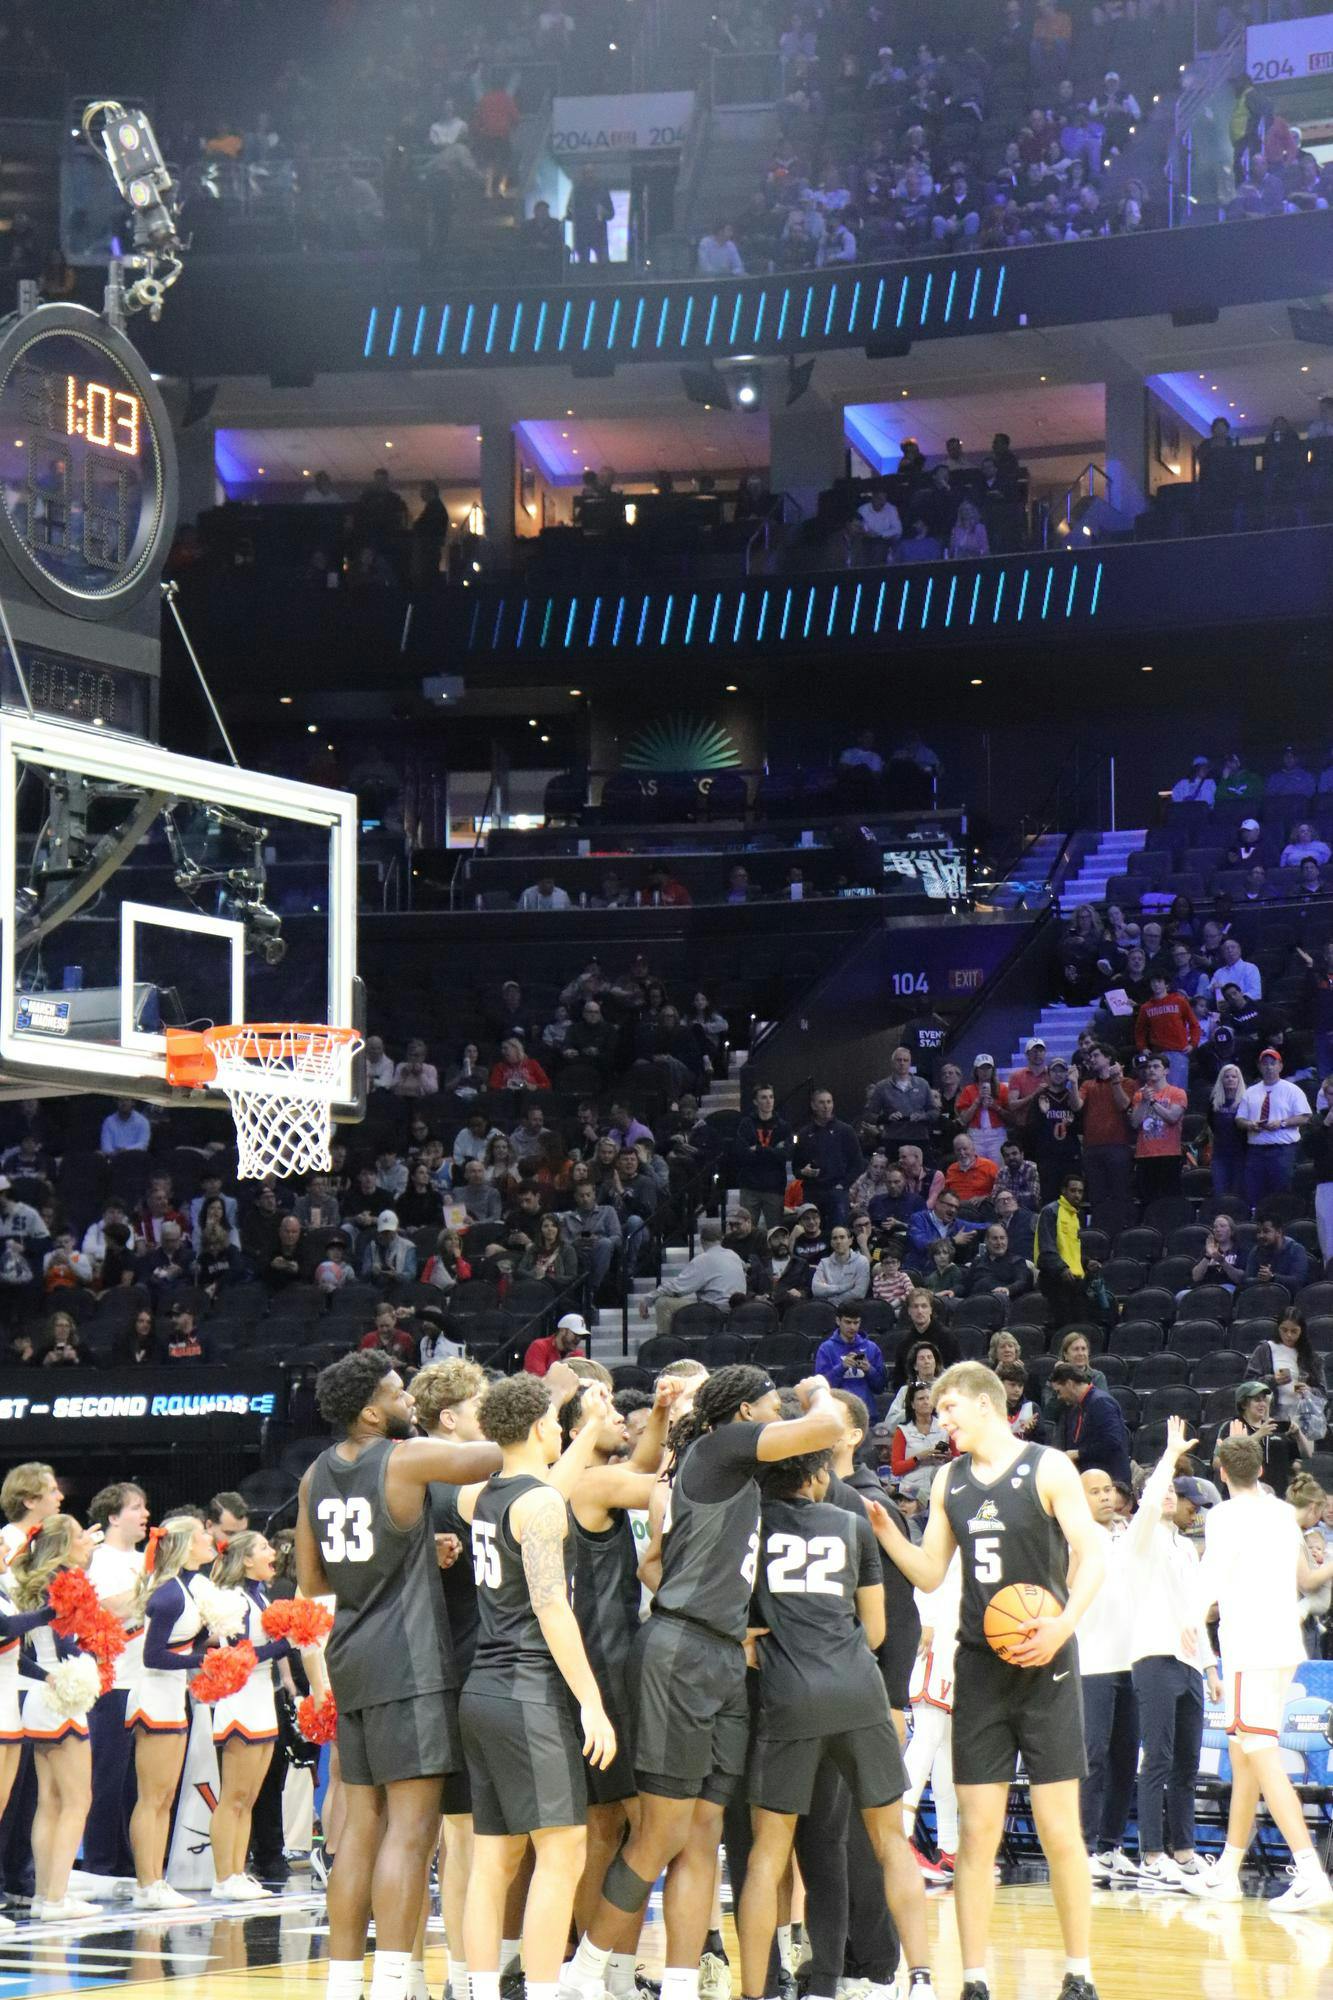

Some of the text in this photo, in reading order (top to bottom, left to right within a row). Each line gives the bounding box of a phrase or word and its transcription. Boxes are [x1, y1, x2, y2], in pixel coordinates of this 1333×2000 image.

[1252, 58, 1294, 81] 204
[555, 130, 609, 149] 204A
[649, 127, 687, 146] 204
[67, 375, 138, 456] 1:03
[892, 972, 929, 995] 104
[955, 971, 979, 987] EXIT
[53, 1396, 147, 1418] SECOND
[151, 1394, 249, 1416] ROUNDS
[317, 1496, 375, 1563] 33
[471, 1519, 503, 1590] 55
[766, 1532, 847, 1597] 22
[974, 1537, 1002, 1584] 5
[1294, 1714, 1319, 1722] MARCH
